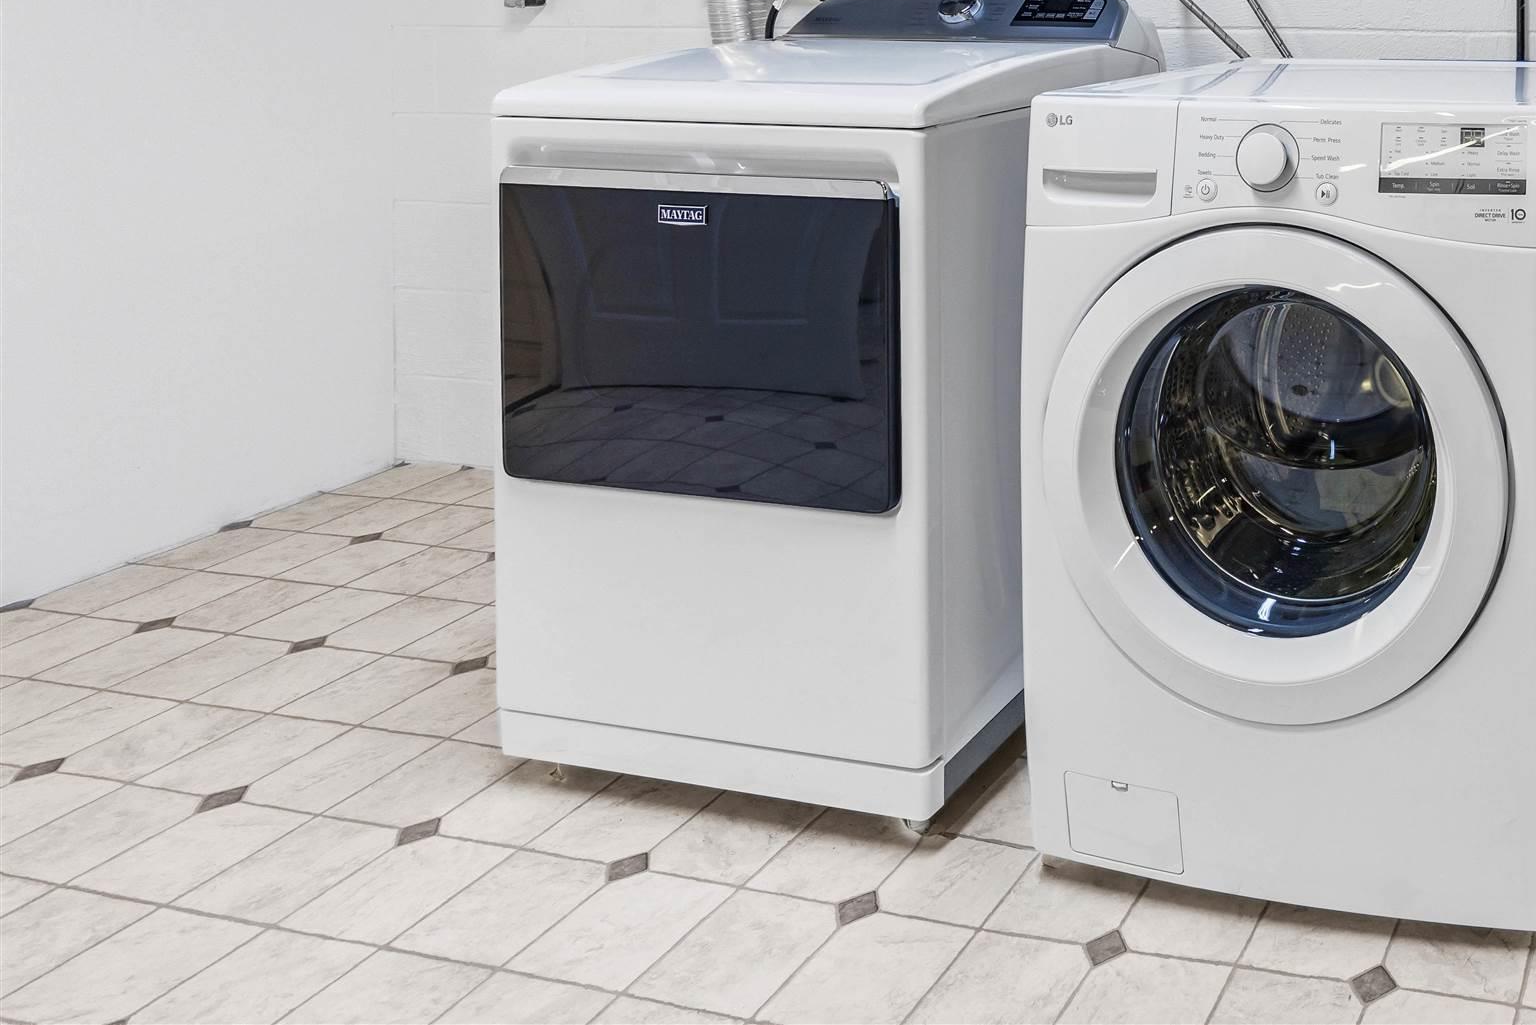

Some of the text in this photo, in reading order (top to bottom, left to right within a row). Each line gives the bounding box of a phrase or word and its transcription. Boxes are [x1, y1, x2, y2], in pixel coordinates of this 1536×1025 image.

[1059, 114, 1073, 126] LG
[660, 209, 703, 221] MAYTAG
[1511, 208, 1526, 221] 10
